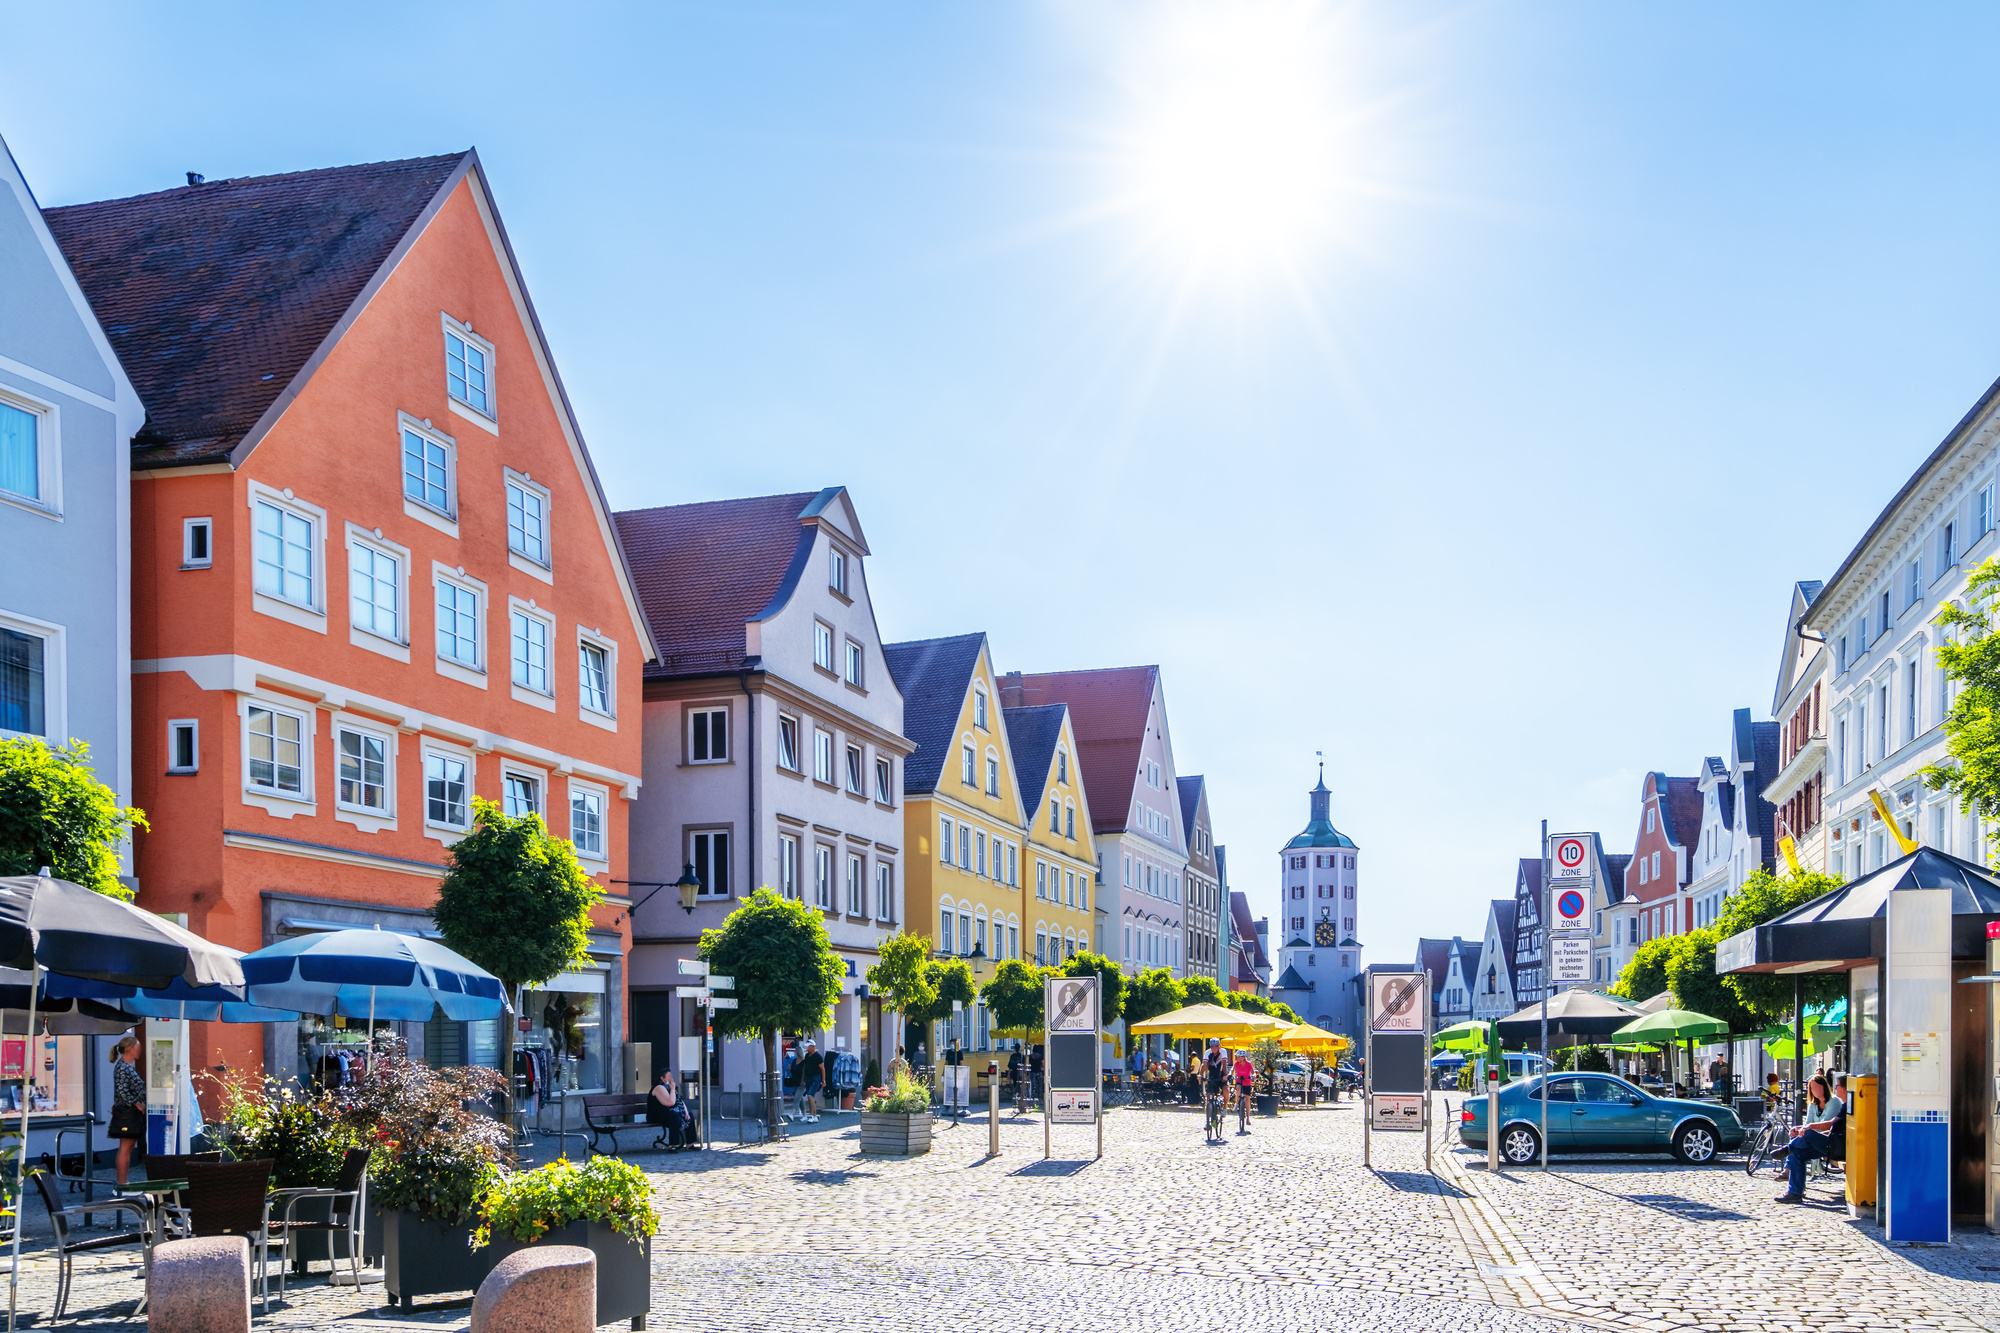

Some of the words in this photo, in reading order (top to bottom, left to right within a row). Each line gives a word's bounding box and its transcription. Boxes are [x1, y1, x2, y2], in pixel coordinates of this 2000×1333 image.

[1565, 847, 1577, 859] 10
[1062, 1019, 1083, 1027] ZONE
[1385, 1018, 1411, 1027] ZONE
